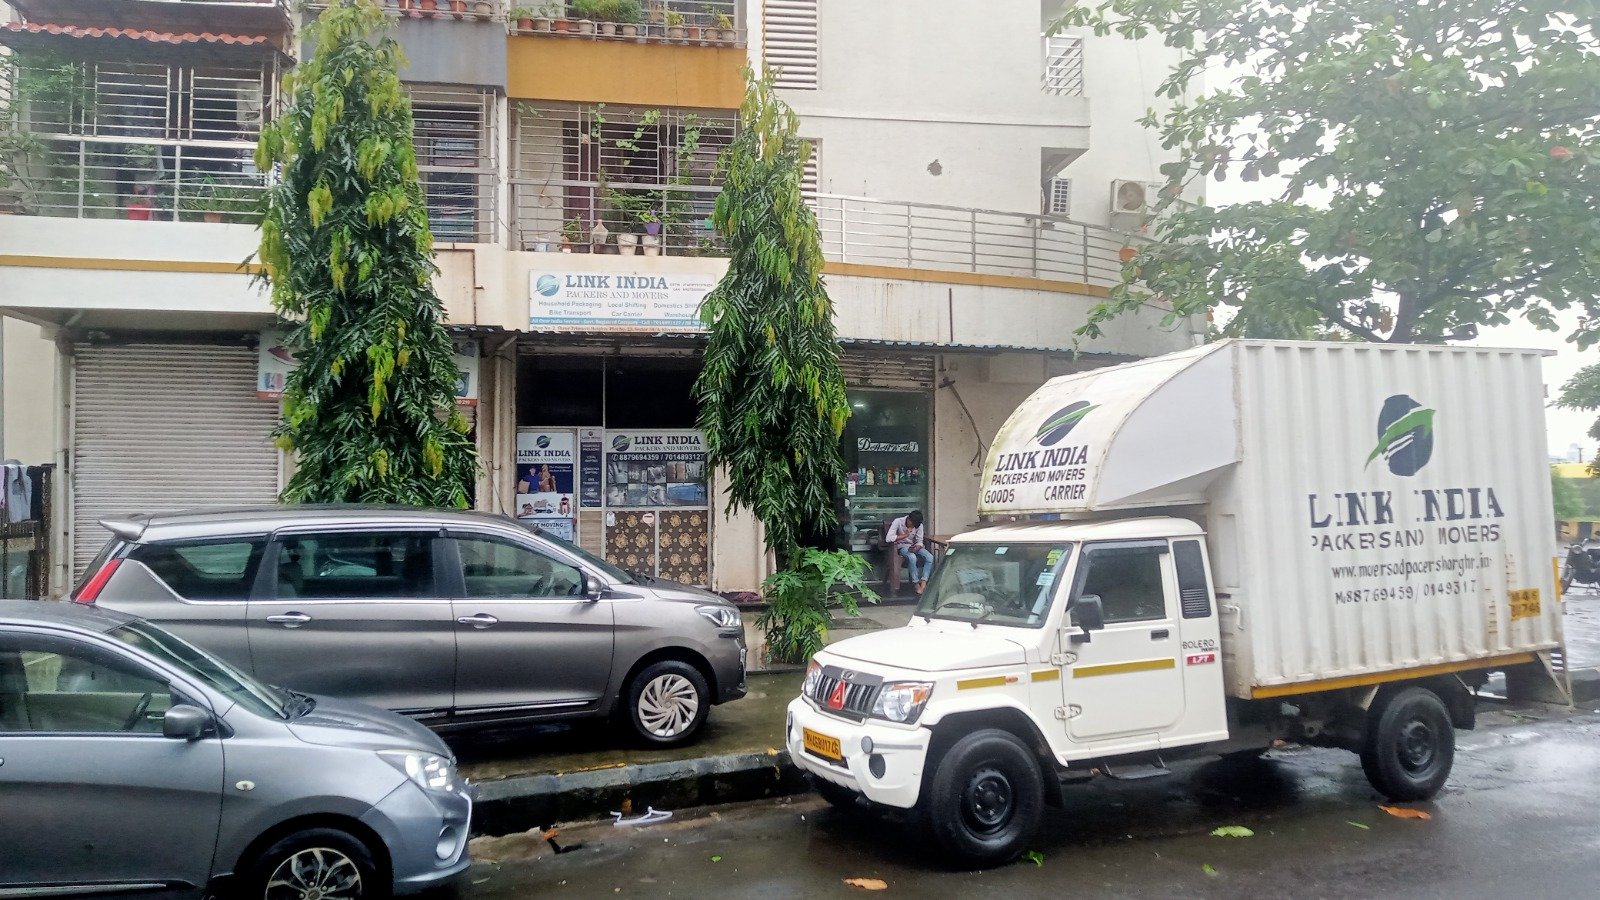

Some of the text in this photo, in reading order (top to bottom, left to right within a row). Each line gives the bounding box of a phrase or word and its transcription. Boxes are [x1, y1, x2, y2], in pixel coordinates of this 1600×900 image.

[566, 274, 610, 288] LINK
[616, 276, 668, 290] INDIA
[566, 290, 668, 300] PACKERS AND MOVERS
[634, 436, 701, 445] LINK INDIA
[995, 445, 1088, 472] LINK INDIA
[991, 468, 1086, 486] PACKERS AND MOVERS
[984, 484, 1086, 504] GOODS CARRIER
[1182, 639, 1215, 649] BOLERO
